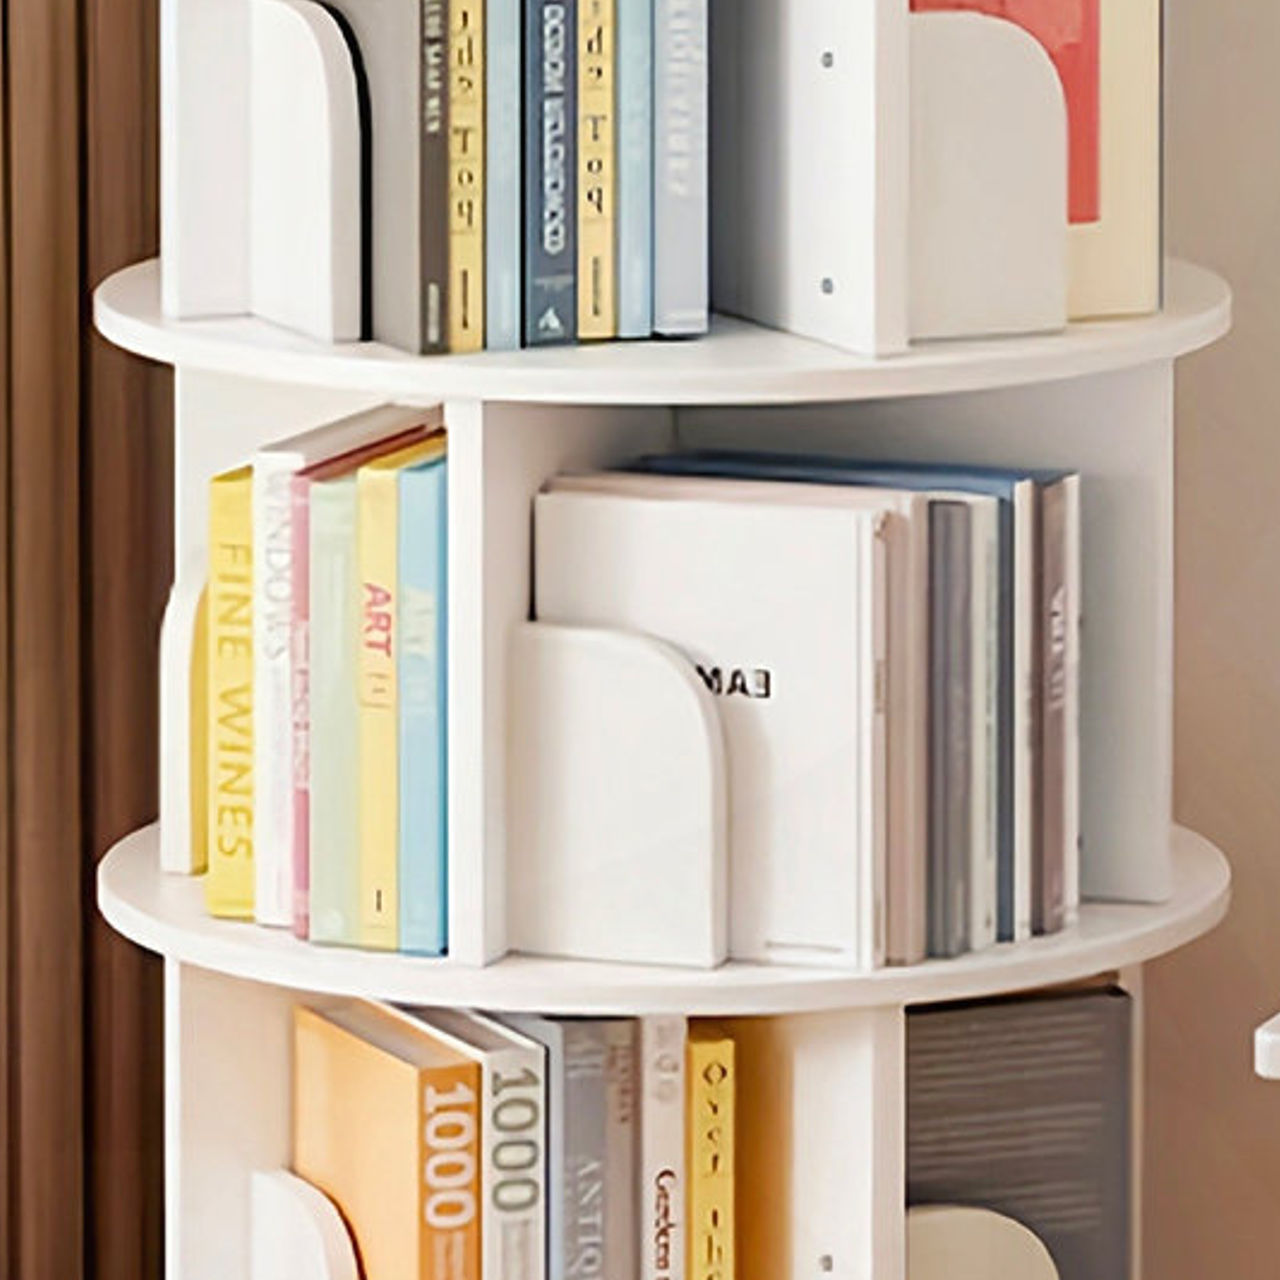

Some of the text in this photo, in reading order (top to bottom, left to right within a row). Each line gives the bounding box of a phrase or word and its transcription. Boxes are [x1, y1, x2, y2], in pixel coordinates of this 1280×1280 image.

[363, 582, 392, 658] ART
[217, 541, 253, 859] FINE WINES
[424, 1081, 477, 1229] 1000
[491, 1067, 541, 1214] 1000
